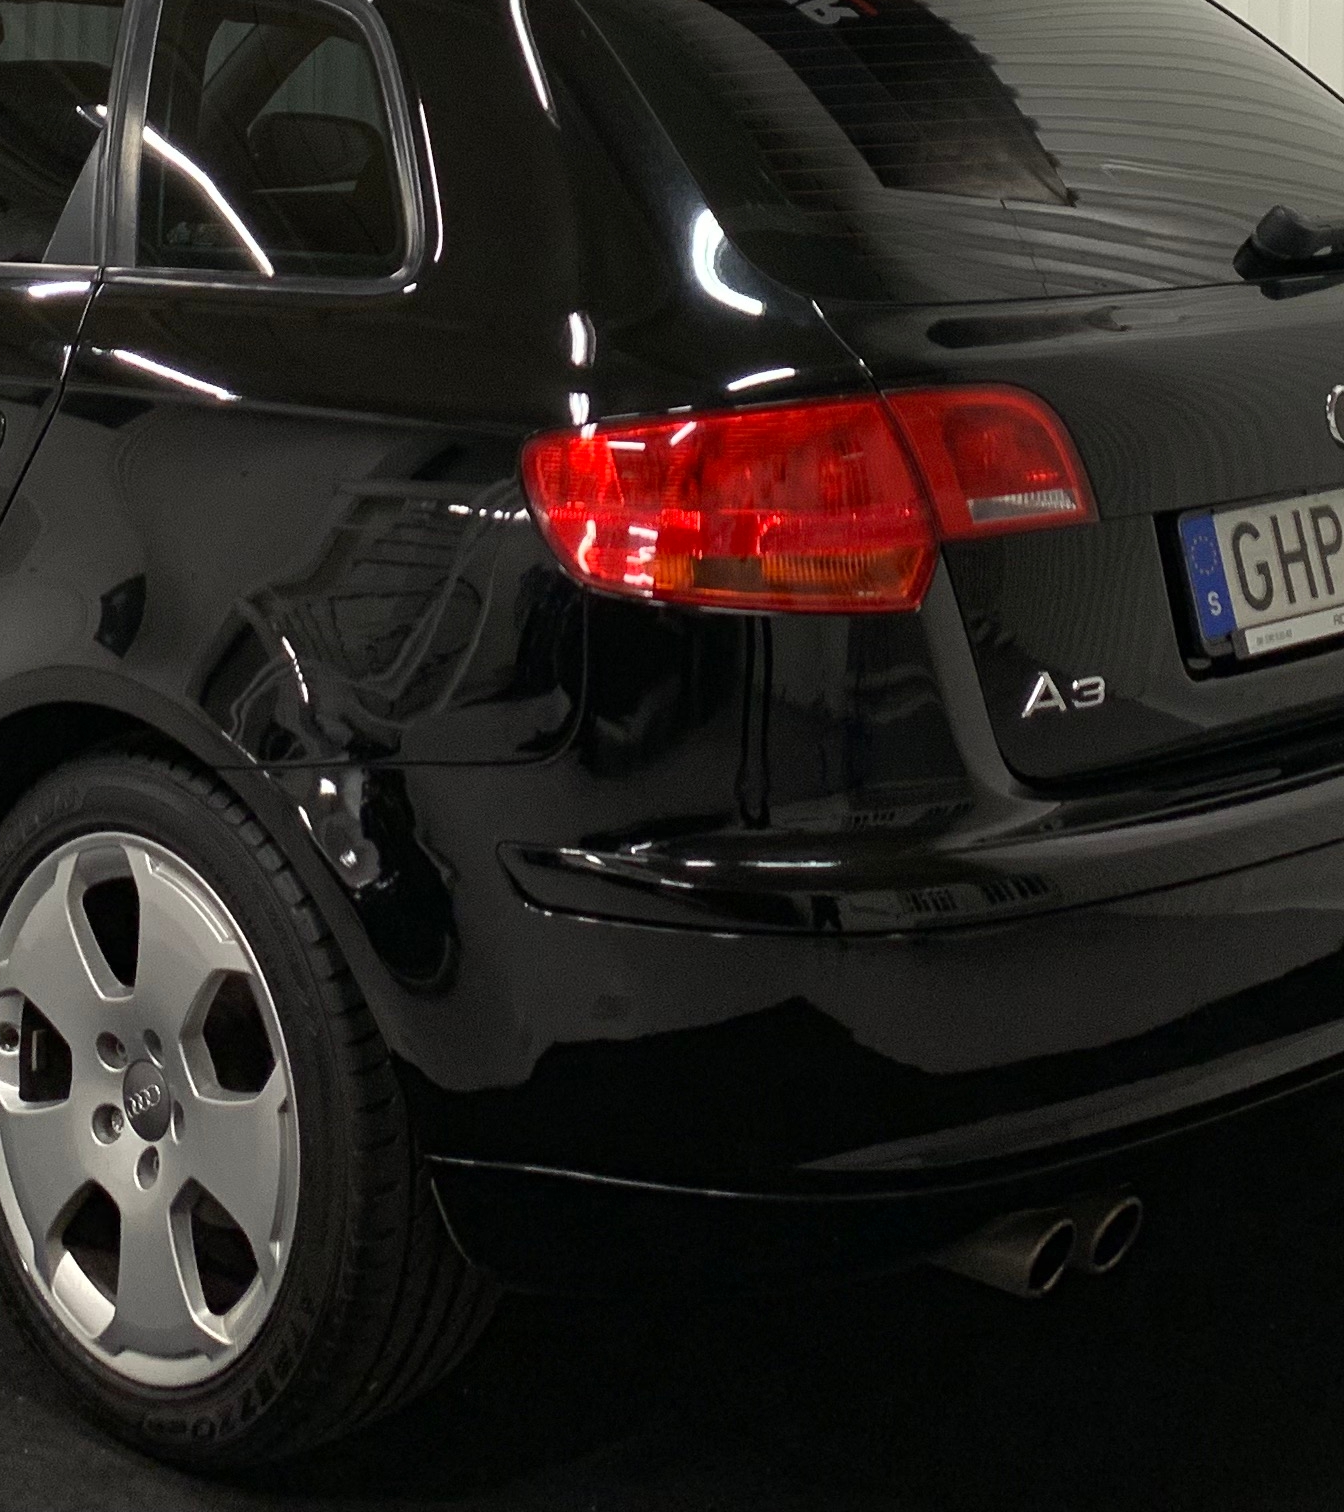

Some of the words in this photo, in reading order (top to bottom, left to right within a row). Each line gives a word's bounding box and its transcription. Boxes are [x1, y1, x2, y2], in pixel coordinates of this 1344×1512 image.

[1231, 504, 1344, 611] GHP
[1207, 590, 1223, 617] S
[1021, 671, 1106, 719] A3
